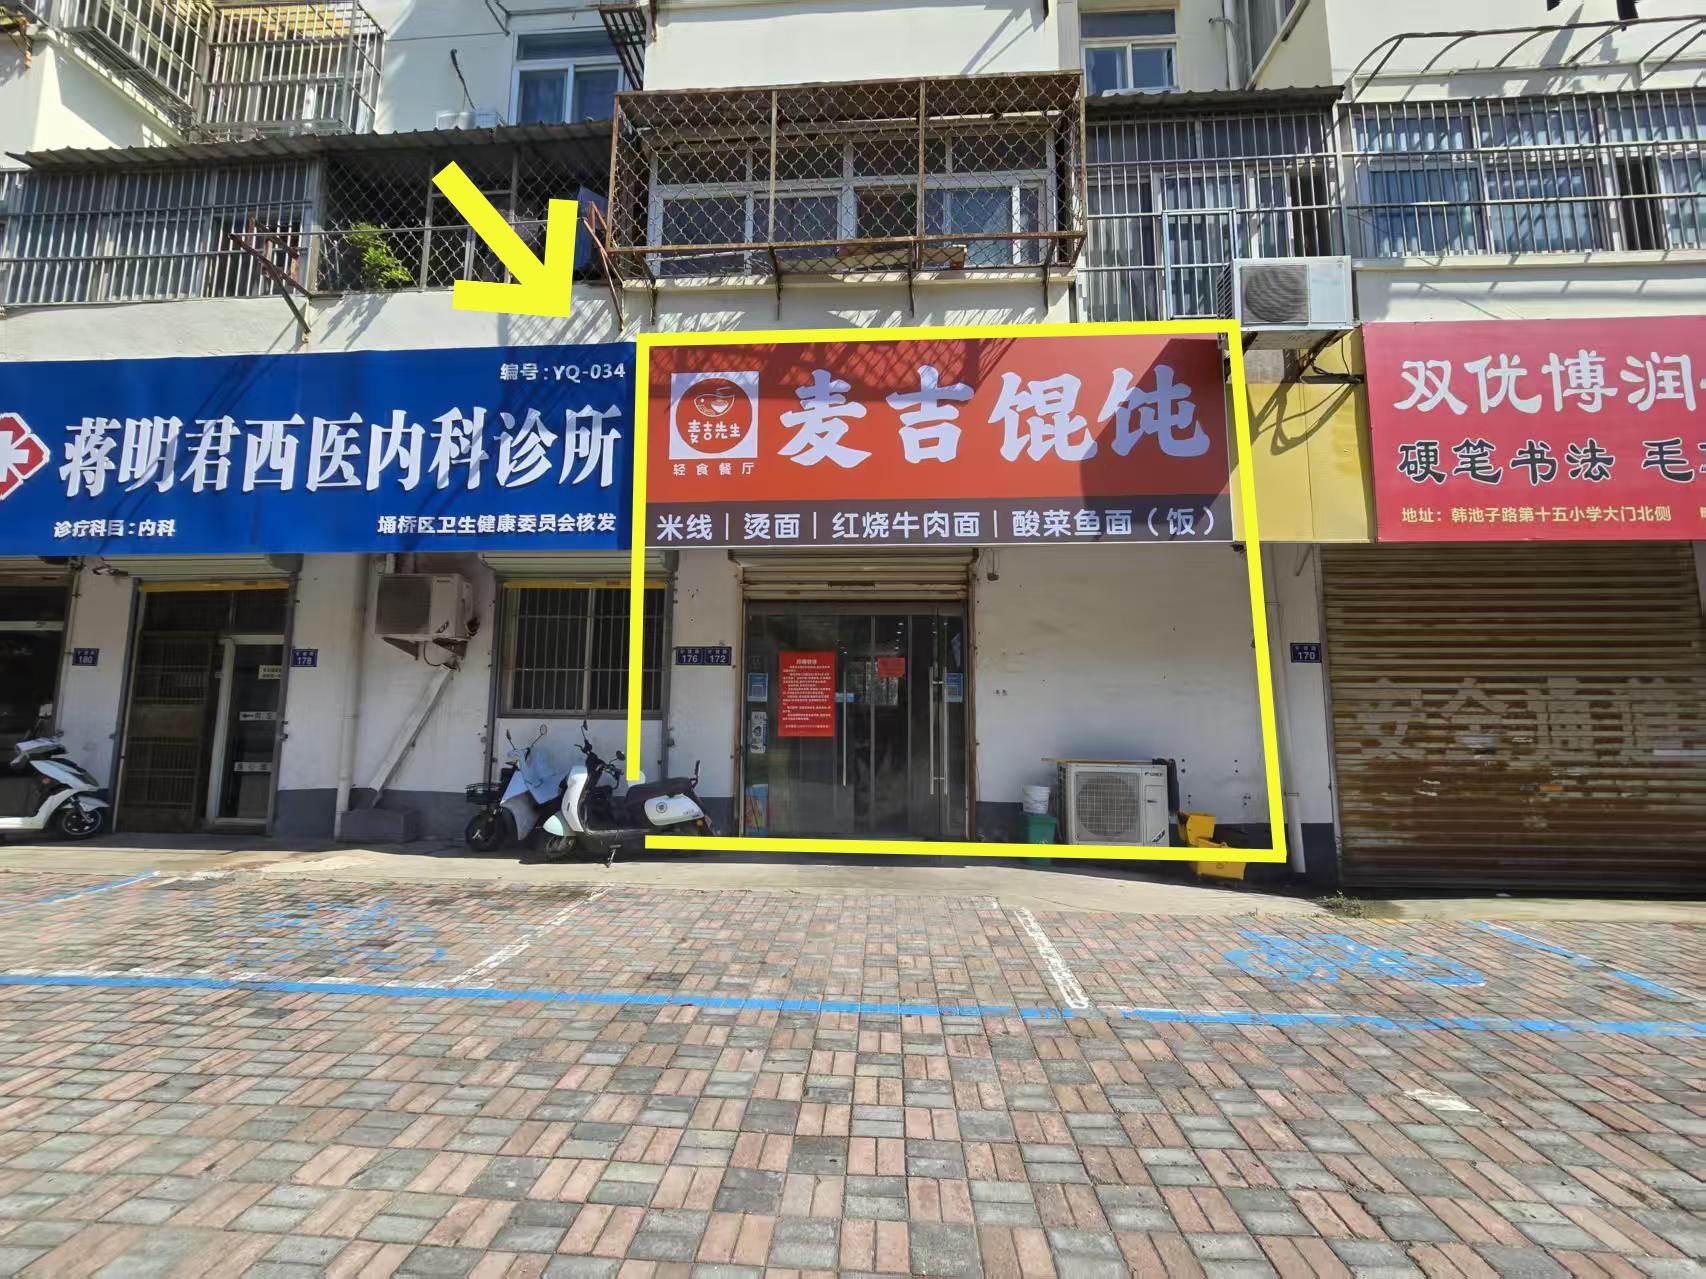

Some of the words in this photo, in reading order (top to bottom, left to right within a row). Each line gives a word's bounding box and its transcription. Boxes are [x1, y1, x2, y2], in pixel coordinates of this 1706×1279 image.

[1394, 350, 1706, 415] 双优博润
[777, 366, 1210, 467] 麦吉馄饨
[688, 419, 741, 445] 麦吉先生
[58, 404, 622, 498] 蒋明君西医内科诊所
[1398, 438, 1615, 485] 硬笔书法
[1641, 436, 1706, 484] 毛
[673, 462, 755, 477] 轻食餐厅
[53, 519, 176, 537] 诊疗科目：内科
[377, 513, 617, 534] 埇桥区卫生健康委员会核发
[656, 514, 713, 543] 米线
[743, 512, 800, 540] 烫面
[832, 510, 981, 538] 红烧牛肉面
[78, 655, 93, 664] 180
[297, 656, 312, 665] 178
[682, 654, 698, 663] 176
[709, 654, 727, 663] 172
[1298, 651, 1316, 660] 170
